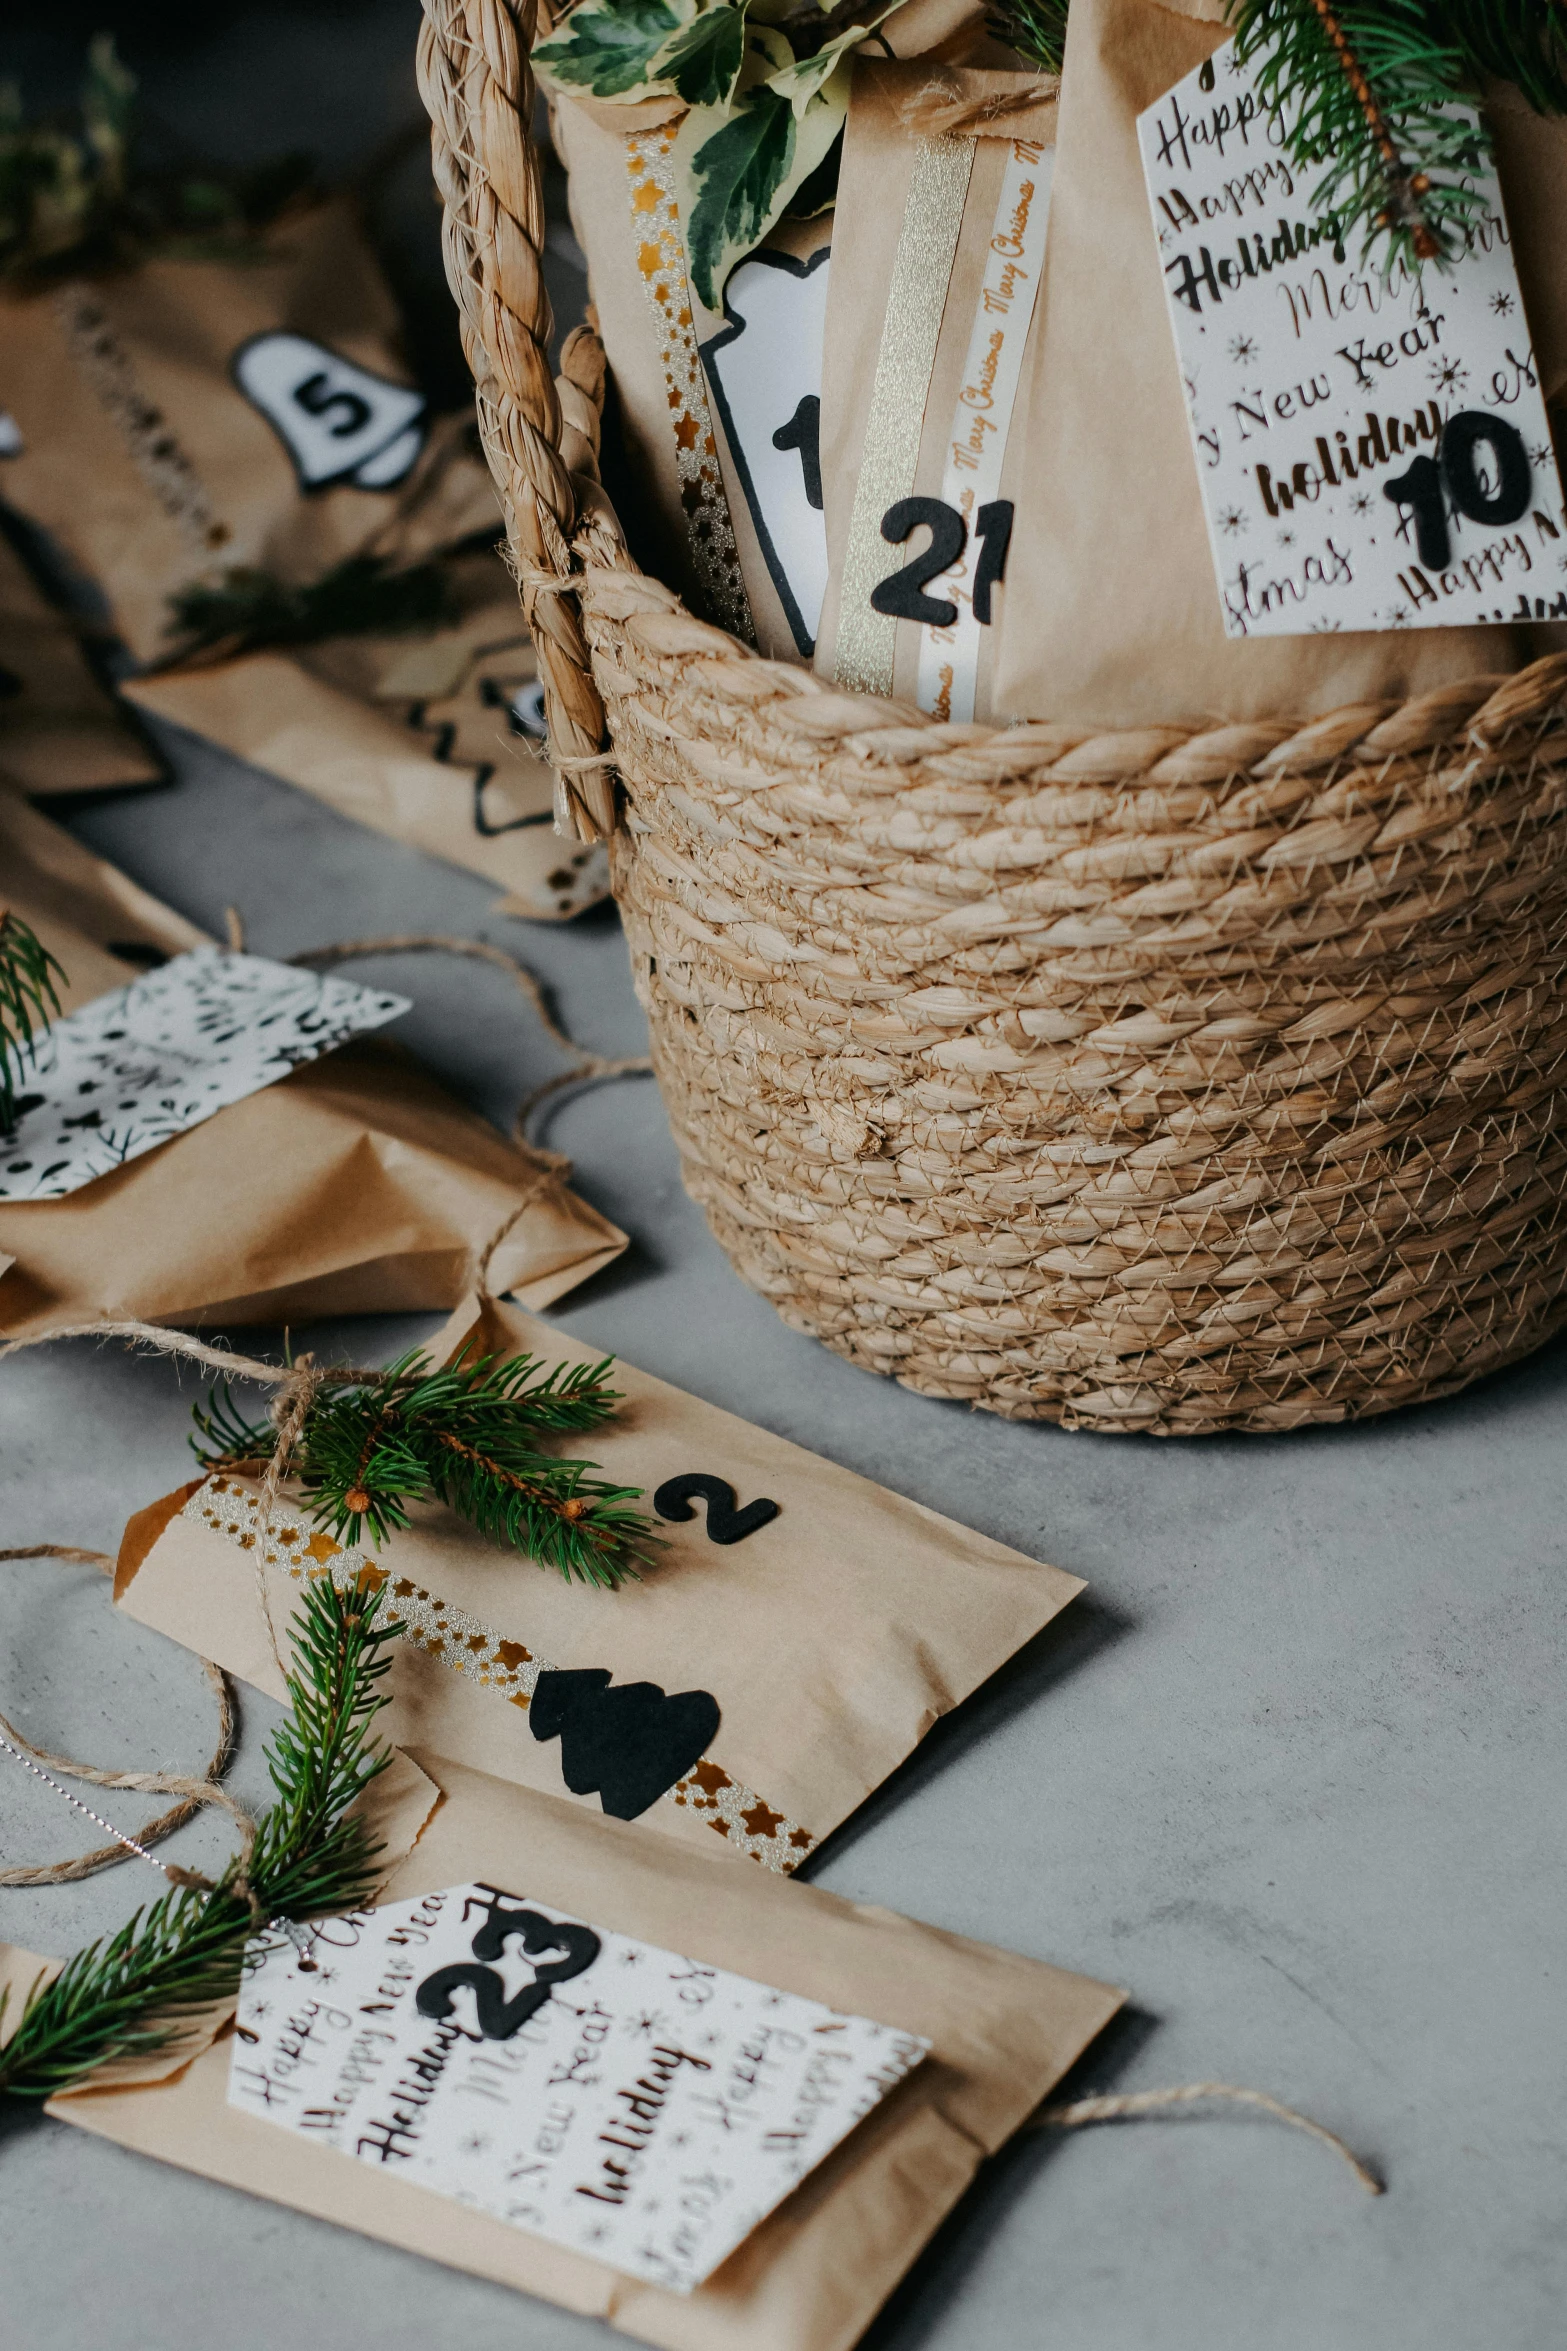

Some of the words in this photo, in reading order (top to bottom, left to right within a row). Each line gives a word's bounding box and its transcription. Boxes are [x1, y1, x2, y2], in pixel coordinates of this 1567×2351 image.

[1156, 95, 1286, 170] Happy
[1157, 160, 1294, 232] Happy
[982, 262, 1028, 314] Merry
[293, 370, 371, 438] 5
[1228, 373, 1333, 441] New
[1334, 313, 1446, 385] Year
[1255, 400, 1448, 518] holiday
[1382, 410, 1533, 573] 10
[870, 496, 1015, 628] 21
[1396, 533, 1533, 611] Happy
[653, 1472, 779, 1545] 2
[415, 1908, 602, 2042] 23
[235, 1998, 352, 2106] Happy
[299, 2028, 397, 2129] Happy
[547, 2001, 614, 2085] Year
[575, 2045, 712, 2205] holiday
